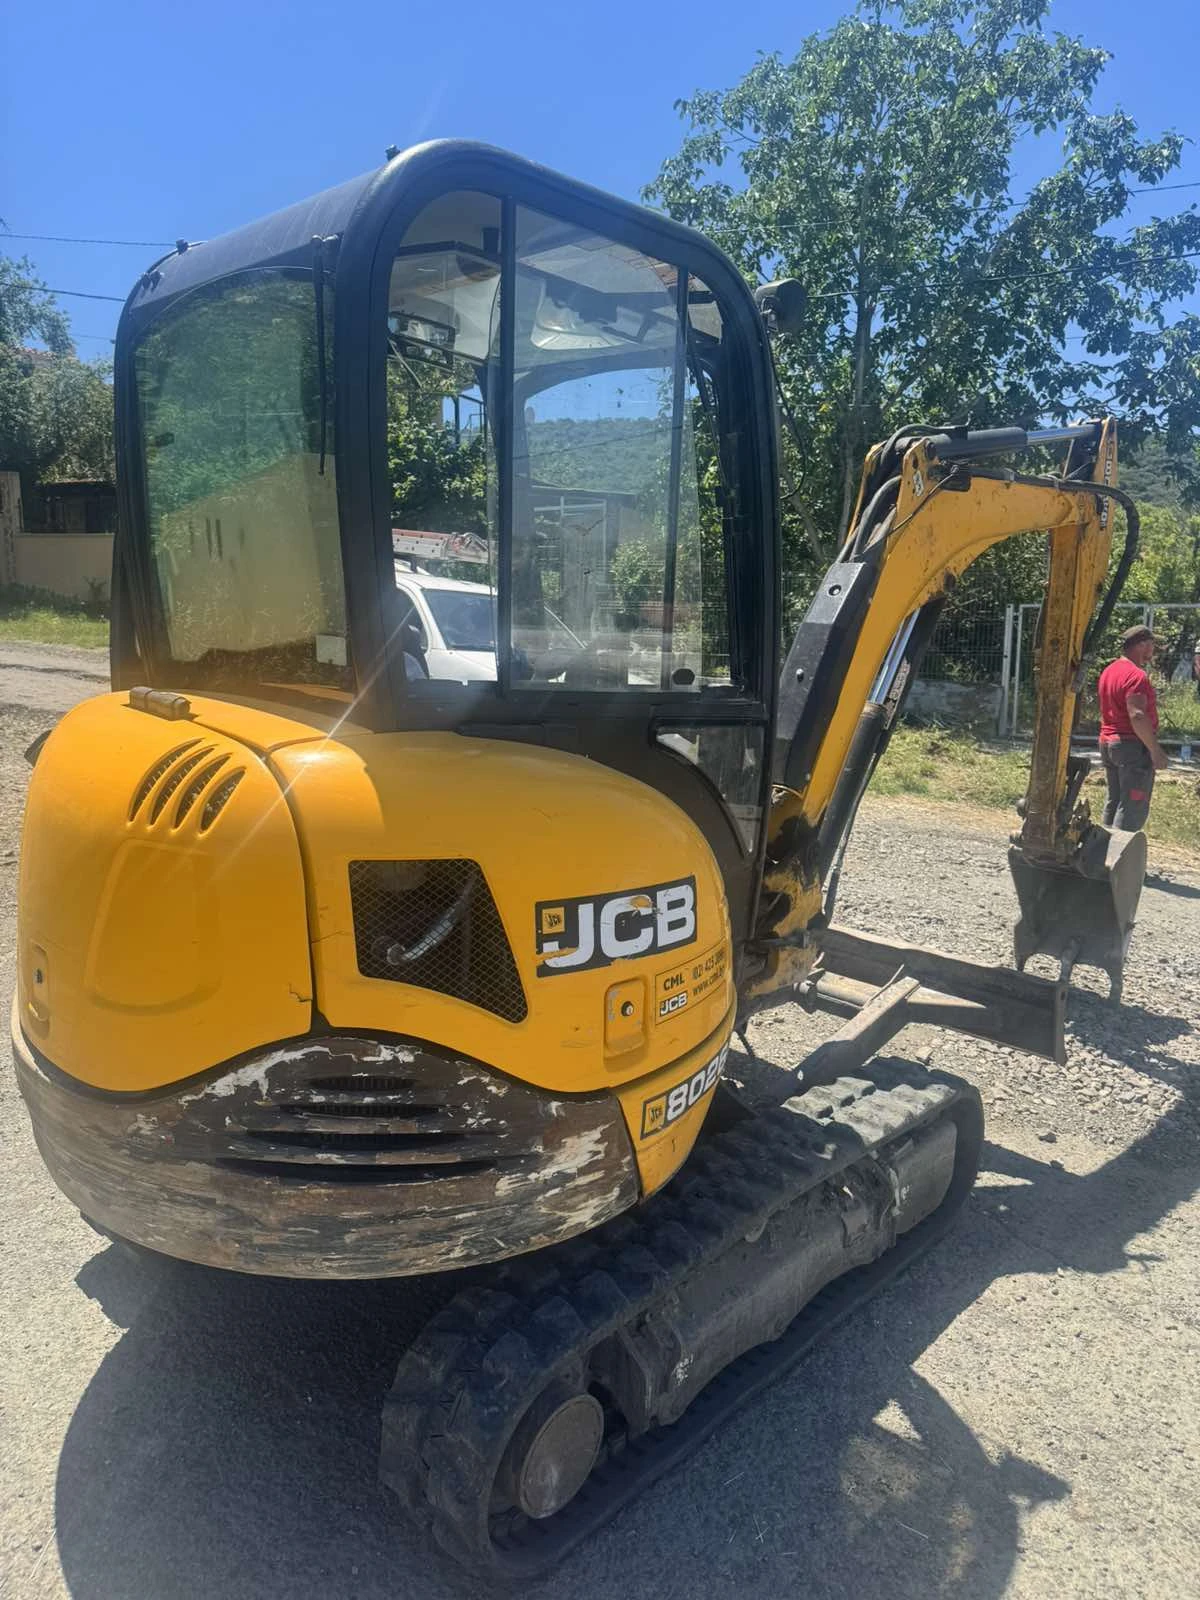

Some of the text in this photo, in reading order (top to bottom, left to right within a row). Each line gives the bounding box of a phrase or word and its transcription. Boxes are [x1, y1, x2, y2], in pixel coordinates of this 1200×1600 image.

[543, 884, 695, 968] JCB
[663, 973, 685, 991] CML
[660, 992, 687, 1015] JCB
